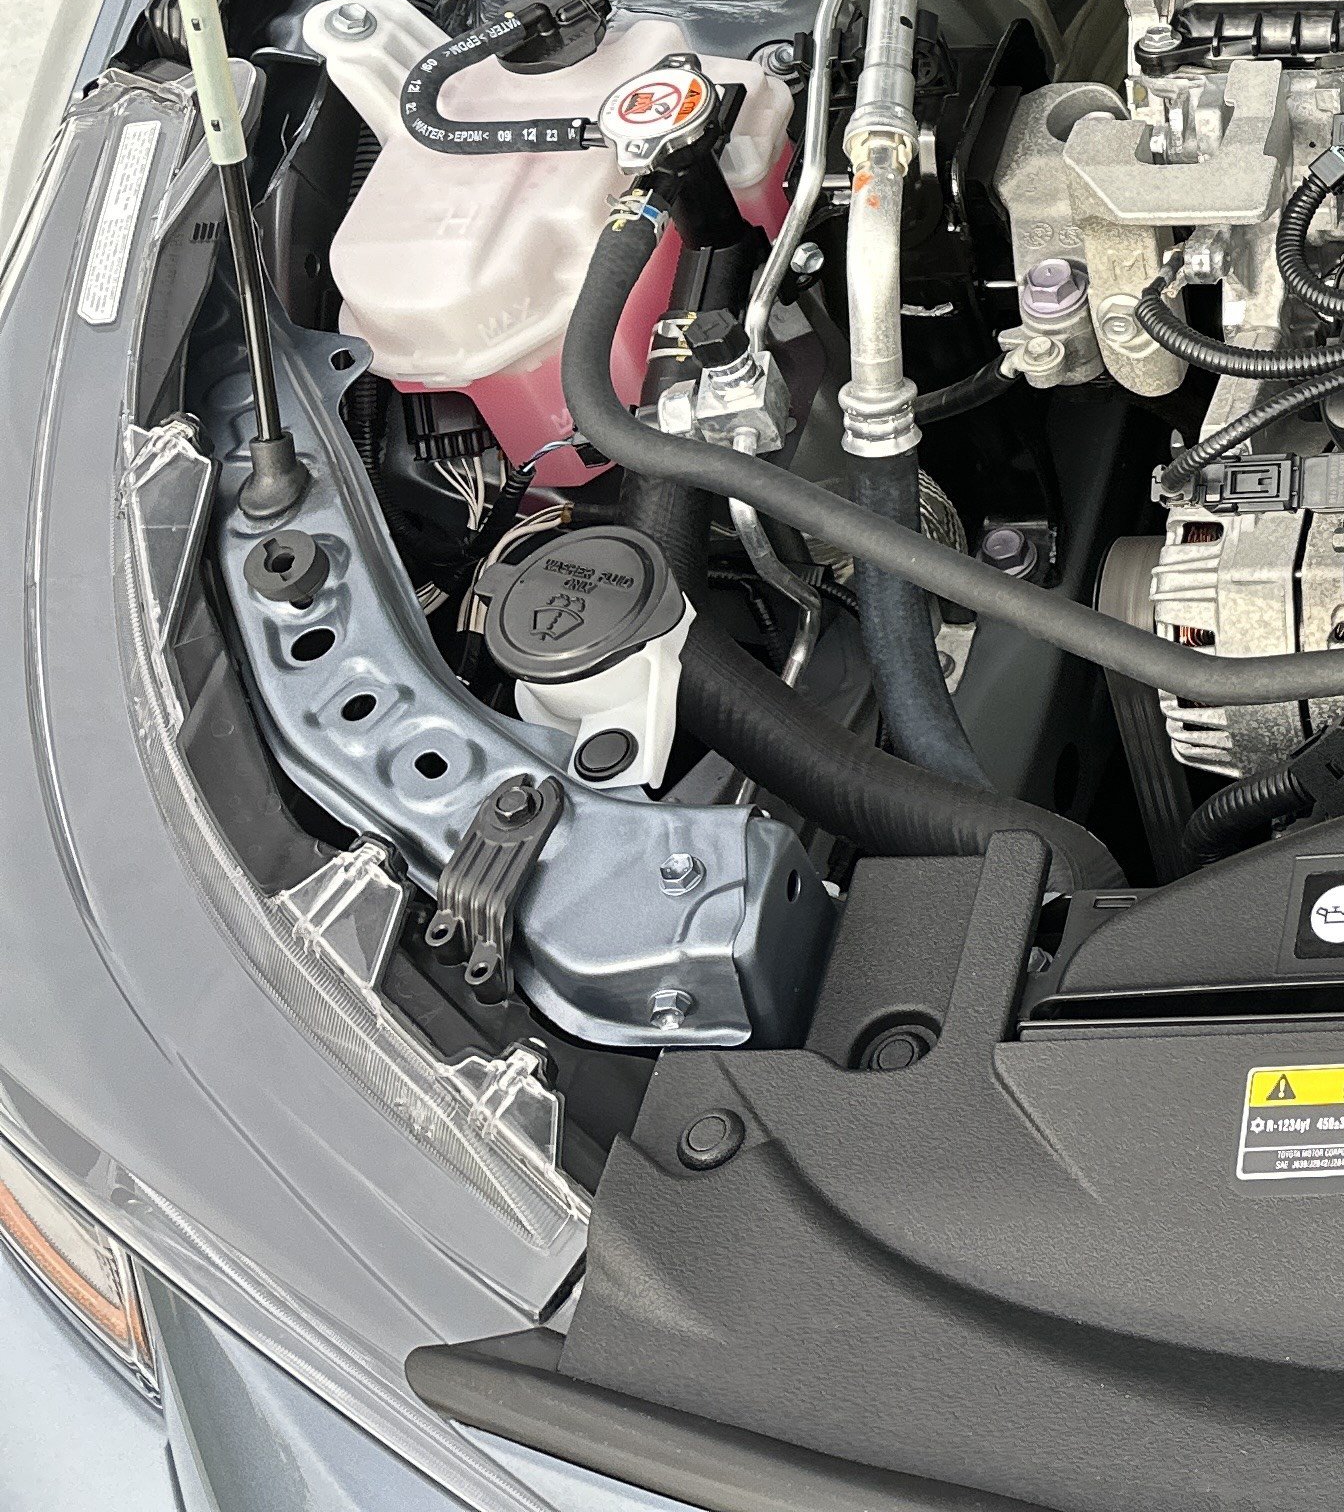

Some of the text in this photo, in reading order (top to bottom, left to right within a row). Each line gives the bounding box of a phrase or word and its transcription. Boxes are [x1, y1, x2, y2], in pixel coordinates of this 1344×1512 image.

[413, 118, 445, 140] WATER
[447, 131, 489, 142] >EPDM<
[563, 578, 598, 594] ONLY
[598, 571, 635, 590] FLUID
[1265, 1117, 1311, 1134] R-1234yf
[1277, 1149, 1301, 1159] TOYOTA
[1302, 1148, 1324, 1158] MOTOR
[1275, 1160, 1288, 1170] SAE
